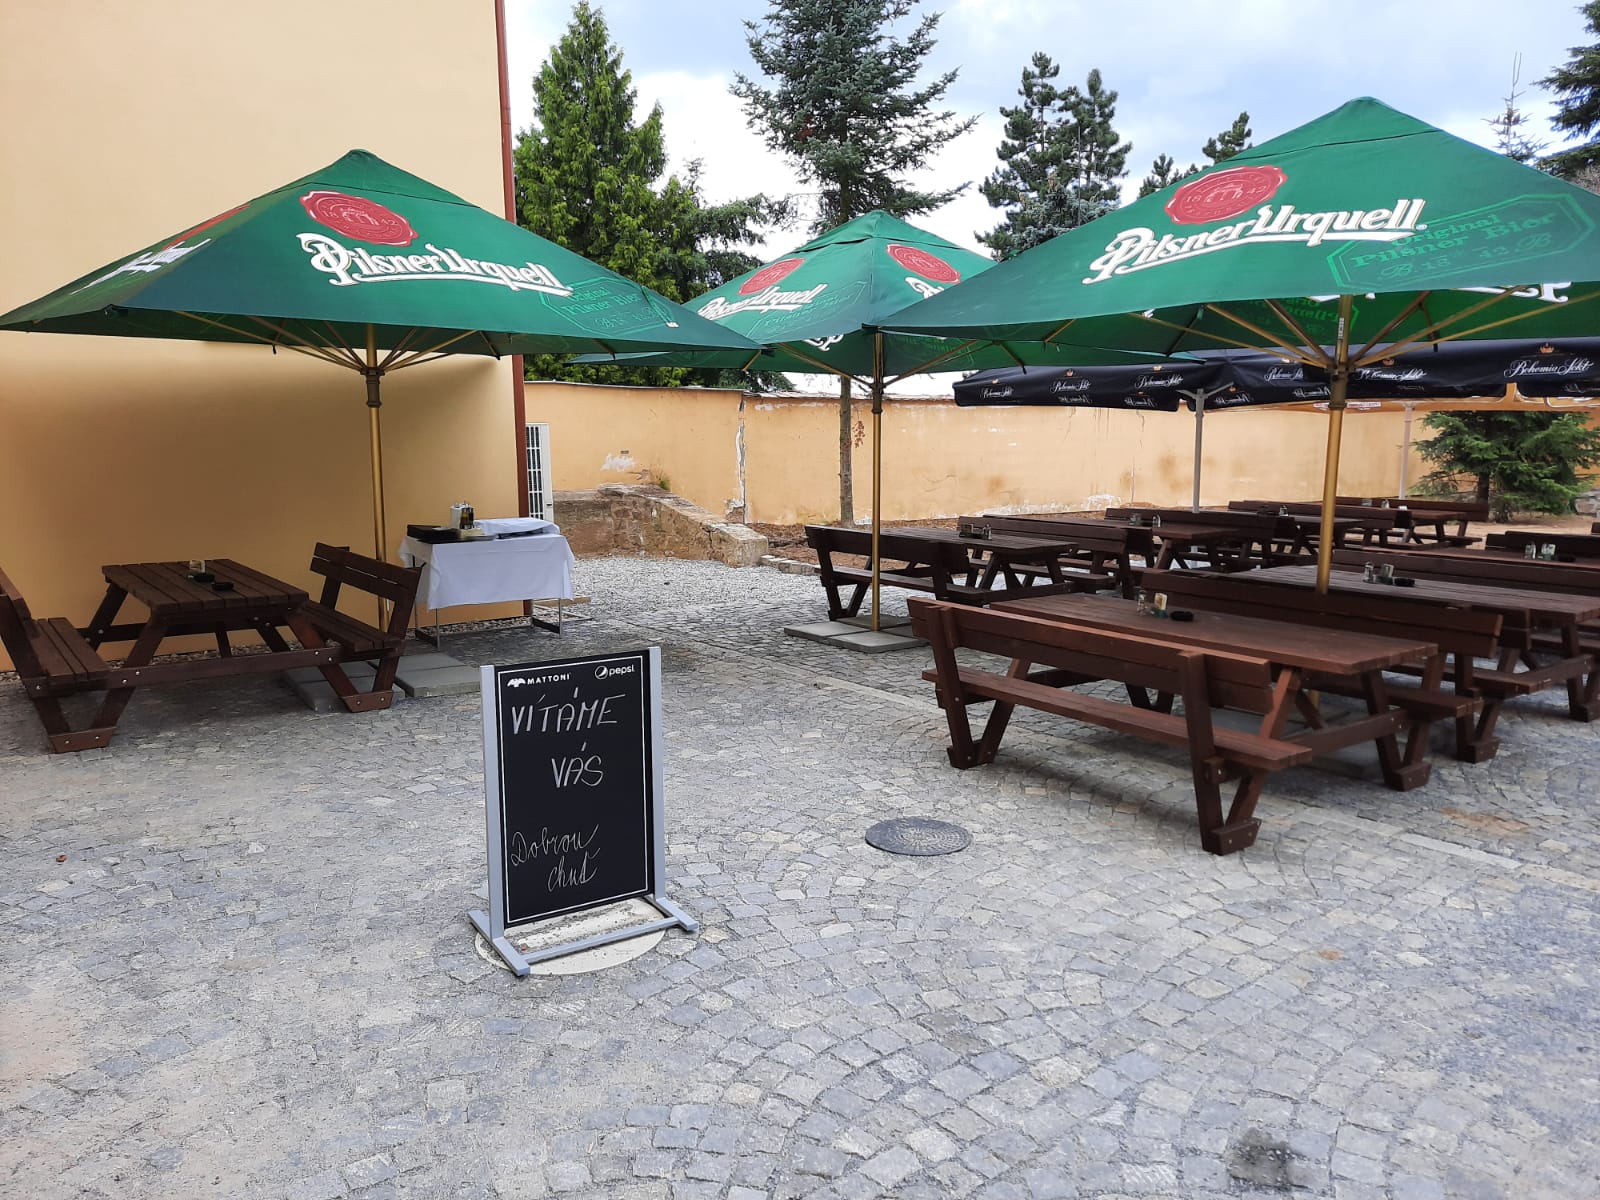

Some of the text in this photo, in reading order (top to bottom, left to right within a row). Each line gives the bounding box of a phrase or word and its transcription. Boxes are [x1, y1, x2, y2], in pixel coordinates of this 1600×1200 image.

[1082, 198, 1428, 285] Pilsner Urquell
[1352, 235, 1470, 268] Pilsner
[296, 233, 574, 296] Pilsner Urquell
[1504, 357, 1594, 378] Bohemia Sekt
[527, 672, 571, 686] MATTONI
[608, 664, 636, 677] pepsi
[511, 686, 627, 736] VÍTÁME
[551, 741, 604, 789] VÁS
[510, 823, 600, 867] Dobrou
